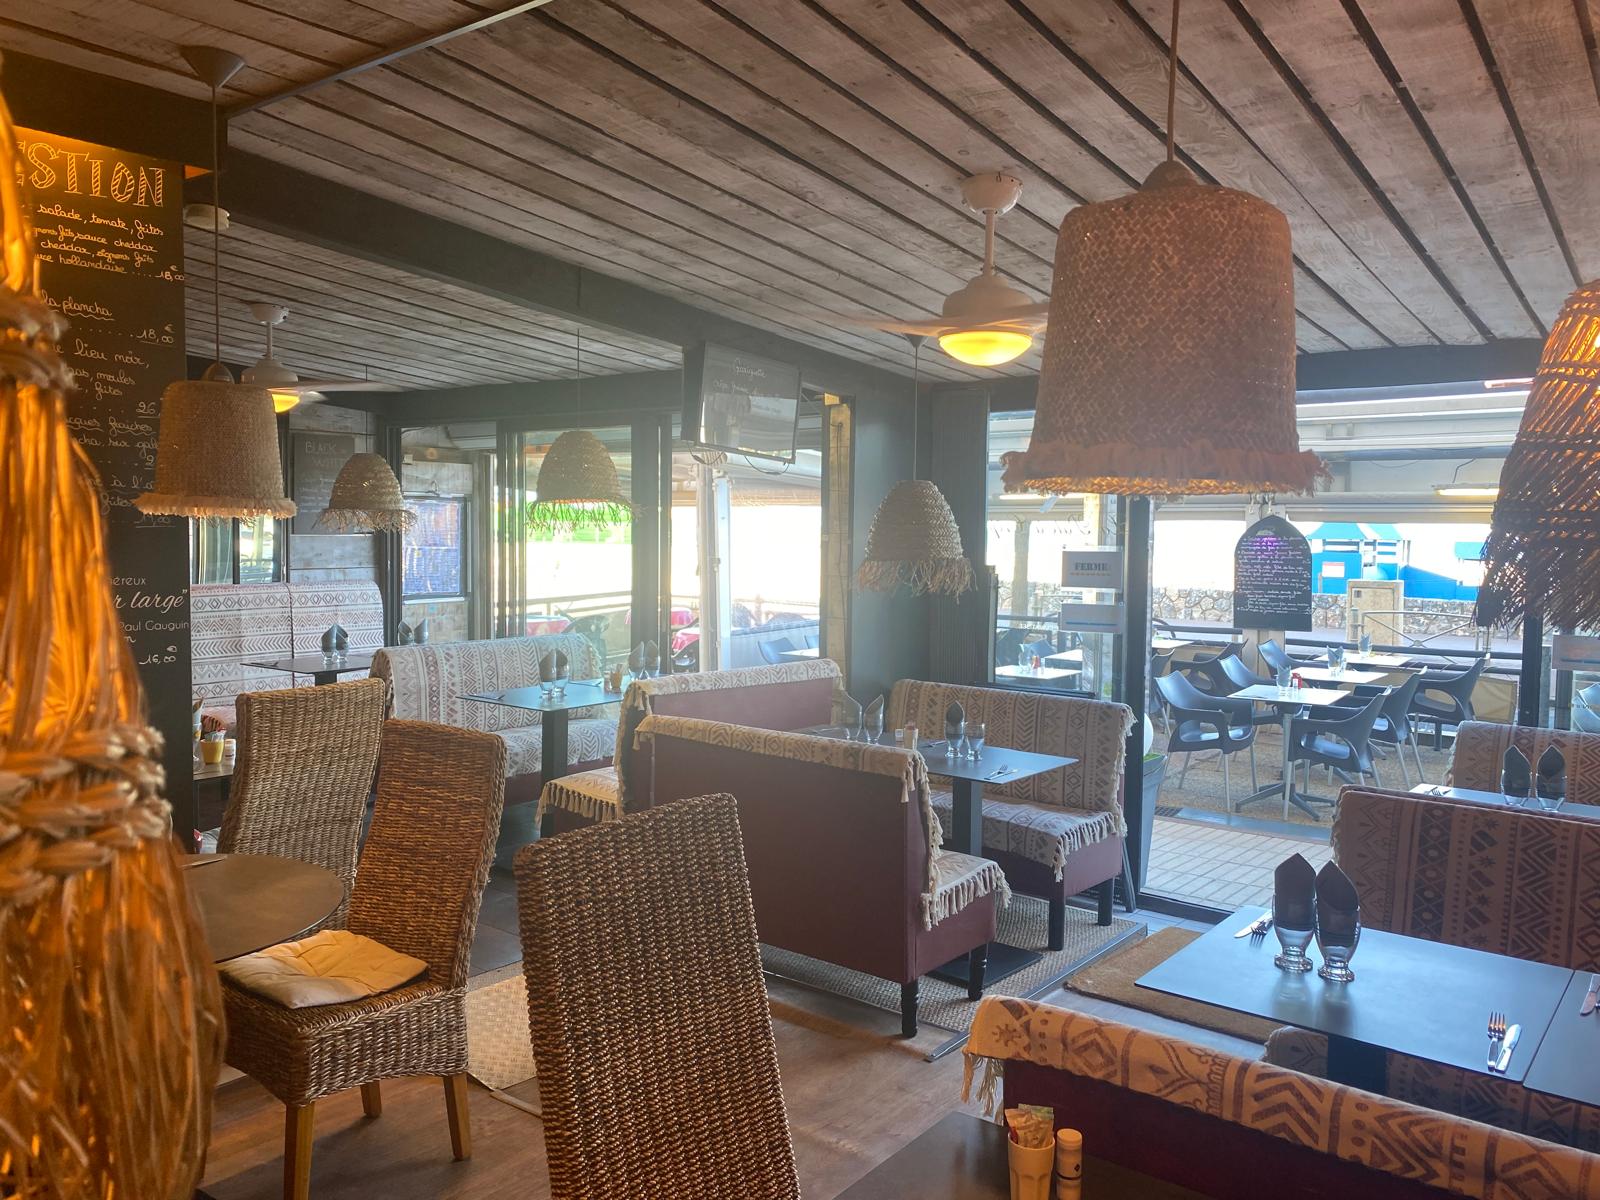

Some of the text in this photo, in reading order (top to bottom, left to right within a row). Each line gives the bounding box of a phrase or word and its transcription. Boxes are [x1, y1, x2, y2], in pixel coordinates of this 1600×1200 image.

[59, 254, 128, 274] hollandaise
[63, 297, 113, 315] plancha
[74, 338, 108, 360] lieu
[145, 620, 190, 632] Gauguin
